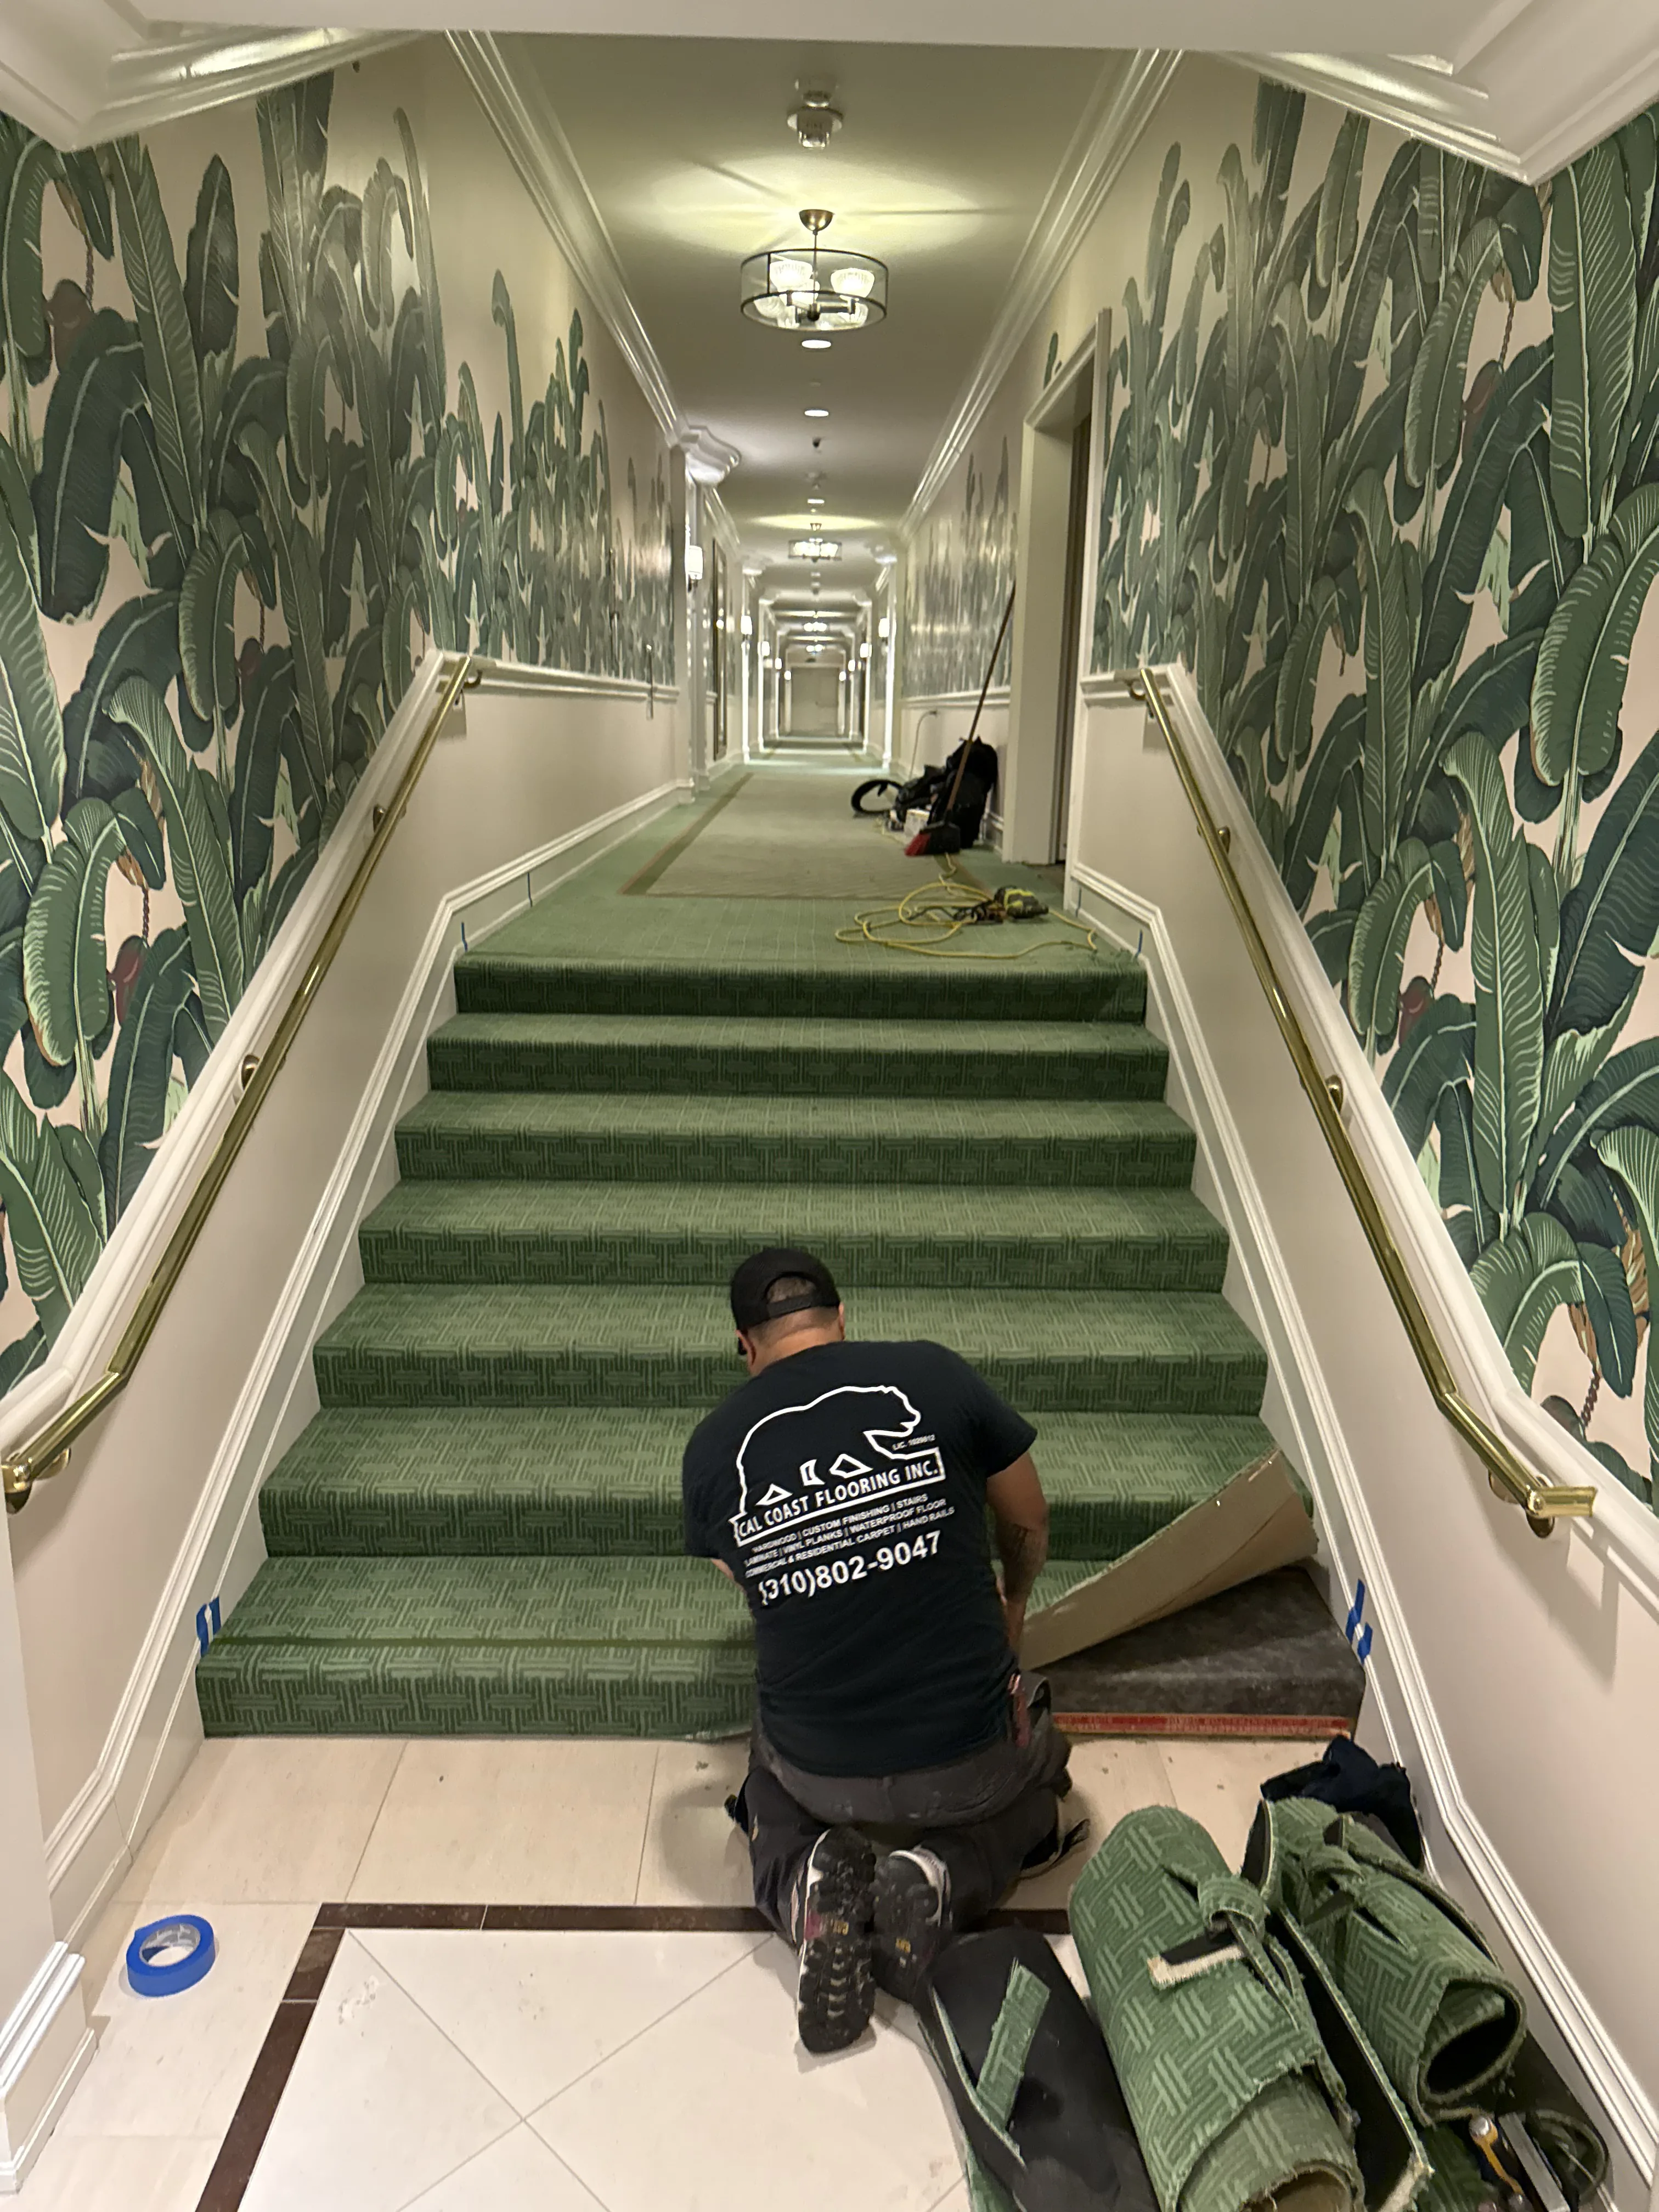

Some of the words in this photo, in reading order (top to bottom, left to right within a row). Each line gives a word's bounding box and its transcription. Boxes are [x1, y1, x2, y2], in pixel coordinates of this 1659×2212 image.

[739, 1516, 763, 1537] CAL
[764, 1496, 809, 1525] COAST
[815, 1468, 900, 1507] FLOORING
[904, 1460, 939, 1481] INC.
[743, 1549, 778, 1567] LAMINATE
[782, 1541, 805, 1554] VINYL
[805, 1530, 843, 1546] PLANKS
[849, 1507, 915, 1533] WATERPROOF
[916, 1498, 946, 1514] FLOOR
[752, 1533, 797, 1553] HARDWOOD
[802, 1519, 840, 1536] CUSTOM
[842, 1505, 890, 1525] FINISHING
[896, 1493, 928, 1509] STAIRS
[758, 1530, 940, 1606] (310)802-9047
[787, 1555, 794, 1564] &
[795, 1538, 856, 1561] RESIDENTIAL
[856, 1525, 895, 1544] CARPET
